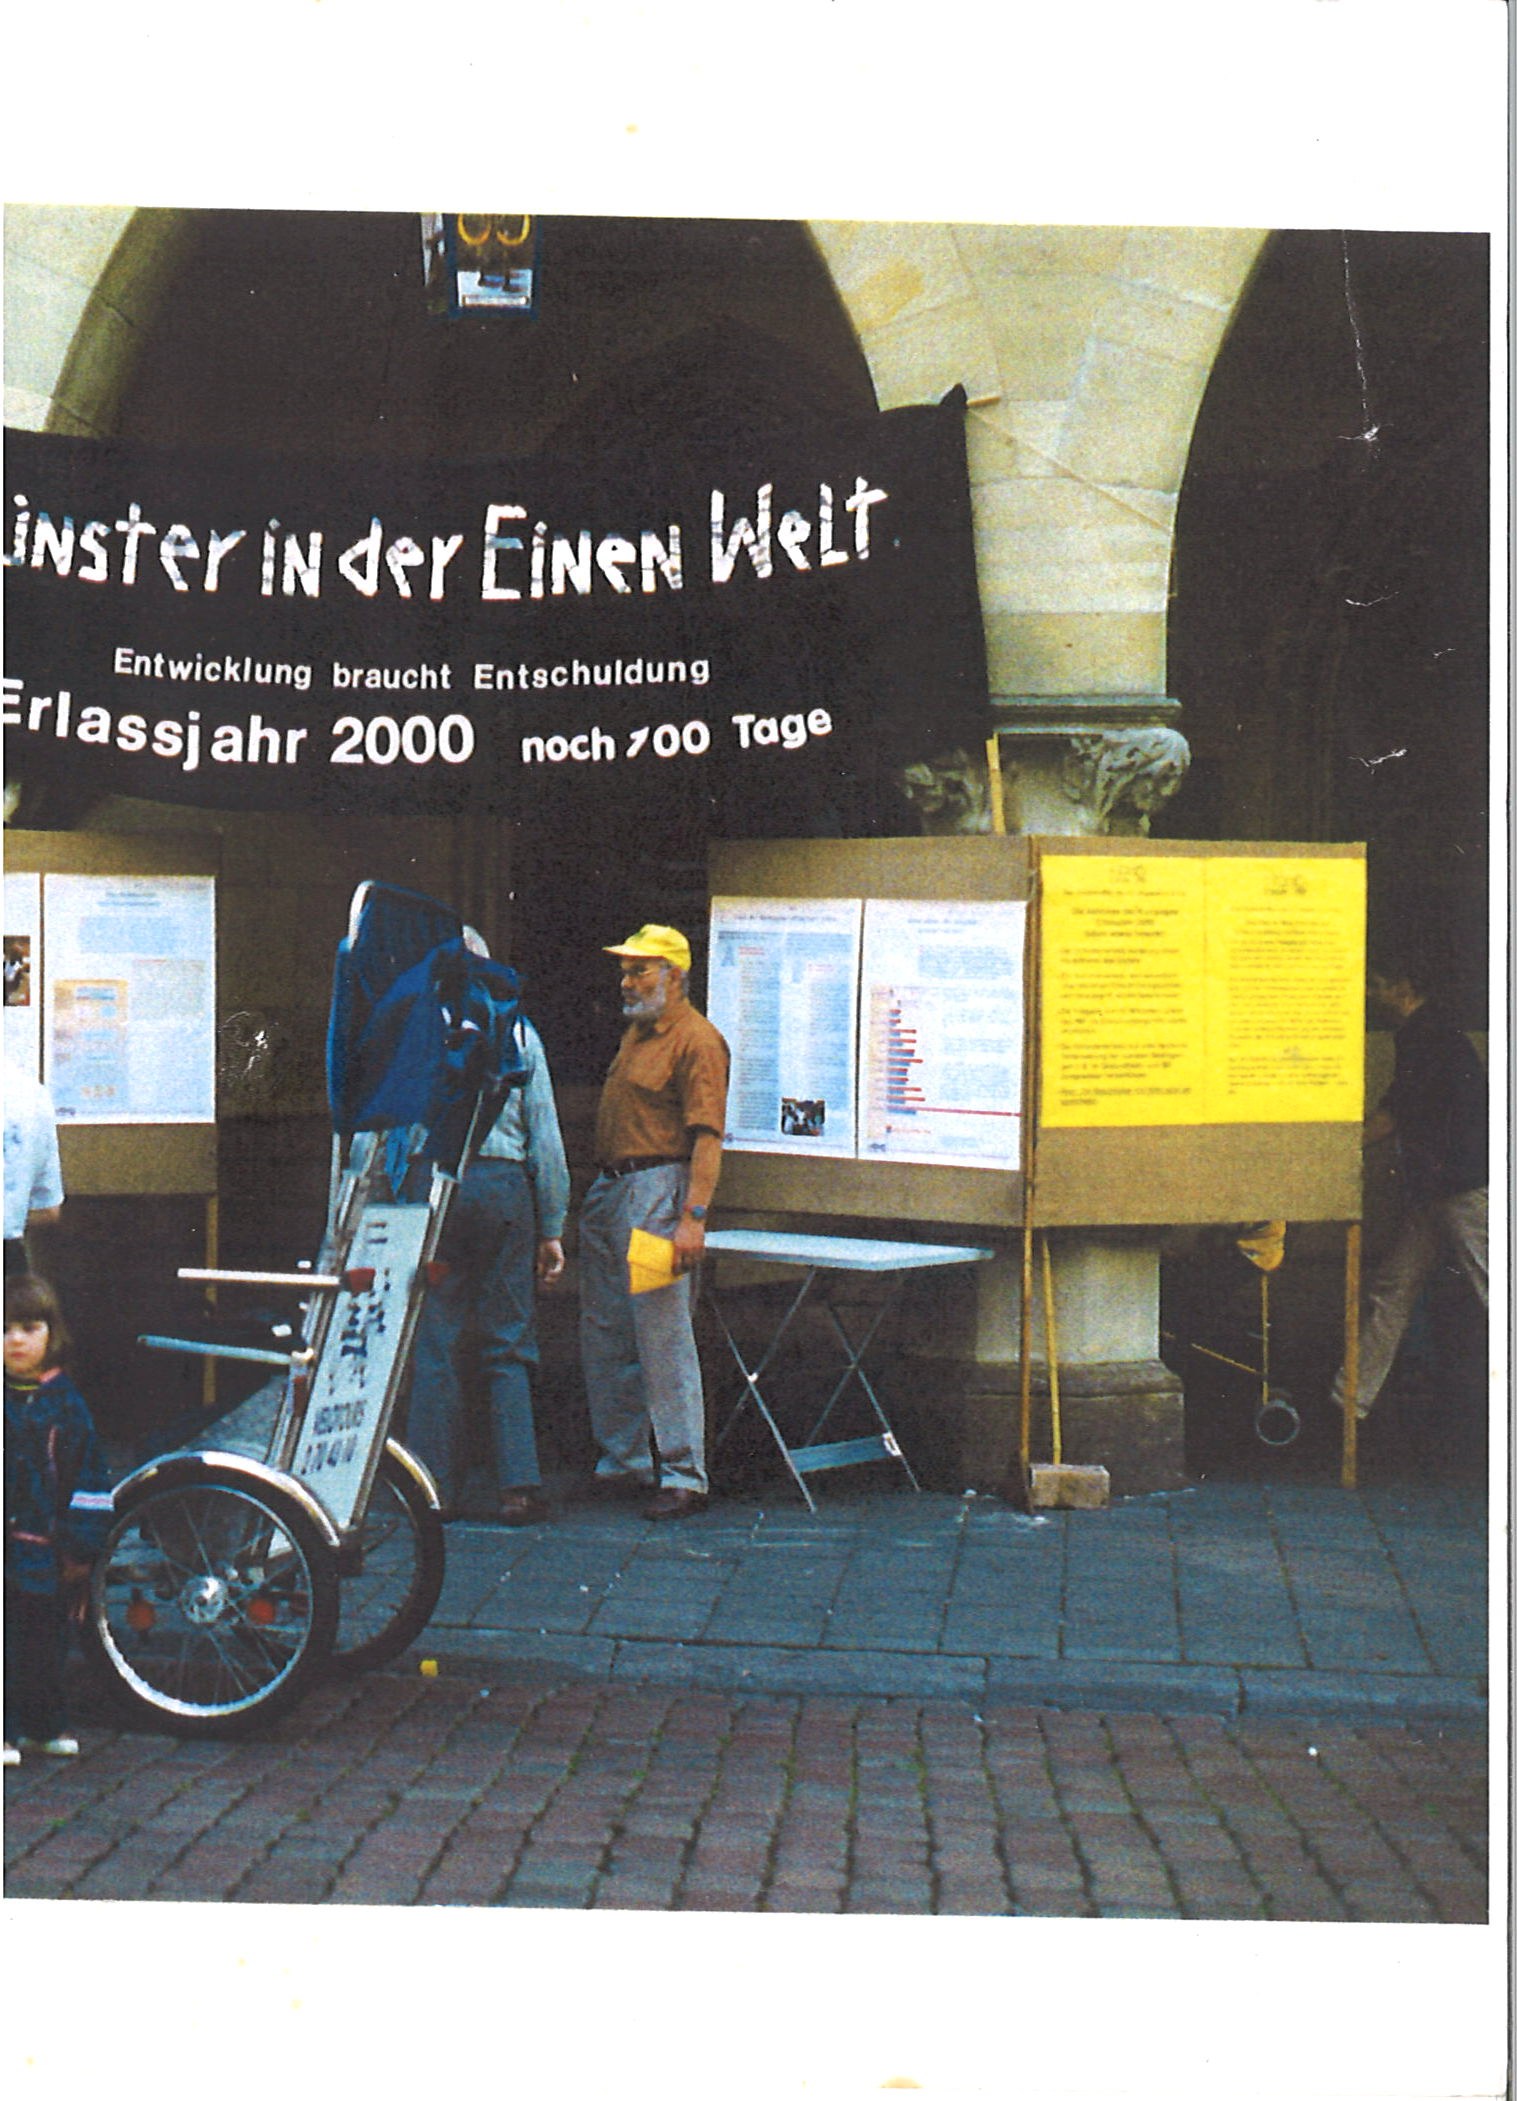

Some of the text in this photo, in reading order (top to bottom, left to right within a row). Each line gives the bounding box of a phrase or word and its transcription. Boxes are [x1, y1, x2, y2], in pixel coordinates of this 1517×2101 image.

[338, 516, 464, 601] der
[114, 647, 710, 690] Entwicklung braucht Entschuldung
[4, 678, 833, 772] Erlassjahr 2000 noch 100 Tage
